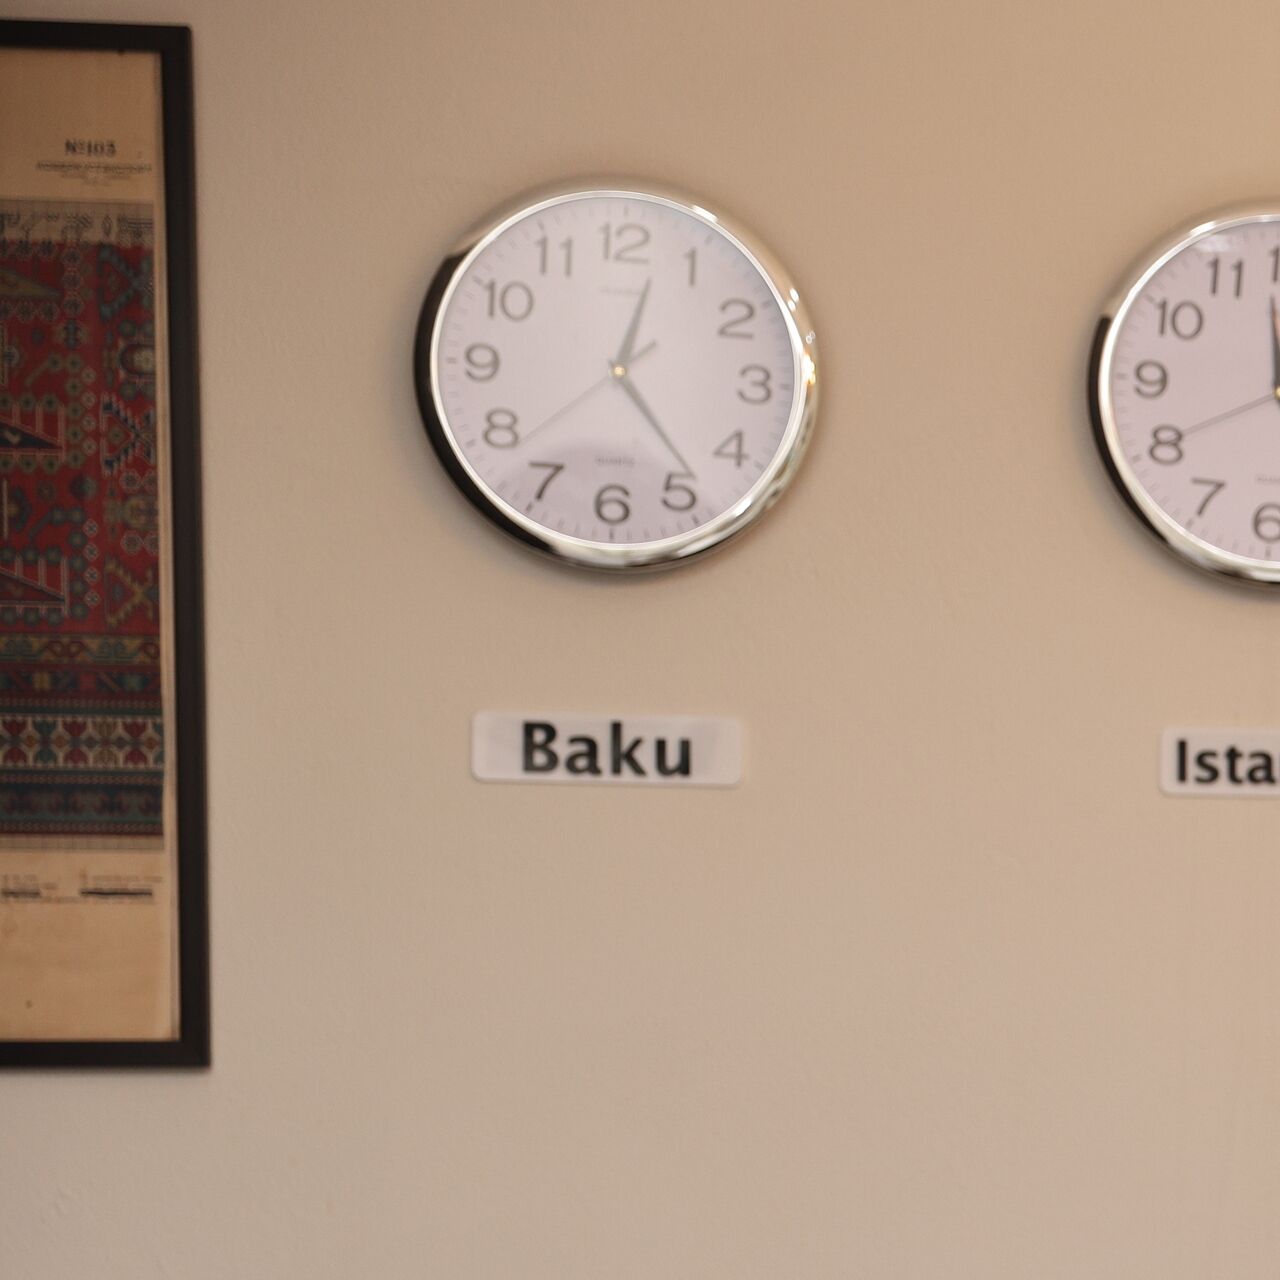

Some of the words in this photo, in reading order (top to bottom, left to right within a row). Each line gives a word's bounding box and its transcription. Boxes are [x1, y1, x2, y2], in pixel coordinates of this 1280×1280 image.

[535, 236, 573, 277] 11
[599, 223, 651, 264] 12
[684, 248, 698, 287] 1
[1207, 257, 1244, 299] 11
[484, 279, 534, 322] 10
[717, 299, 755, 338] 2
[1157, 299, 1204, 341] 10
[465, 343, 500, 382] 9
[1134, 360, 1168, 399] 9
[738, 365, 772, 404] 3
[482, 408, 520, 449] 8
[1148, 425, 1184, 465] 8
[714, 431, 749, 467] 4
[529, 461, 564, 501] 7
[661, 473, 697, 512] 5
[1191, 478, 1226, 516] 7
[594, 484, 631, 525] 6
[522, 721, 692, 777] Baku
